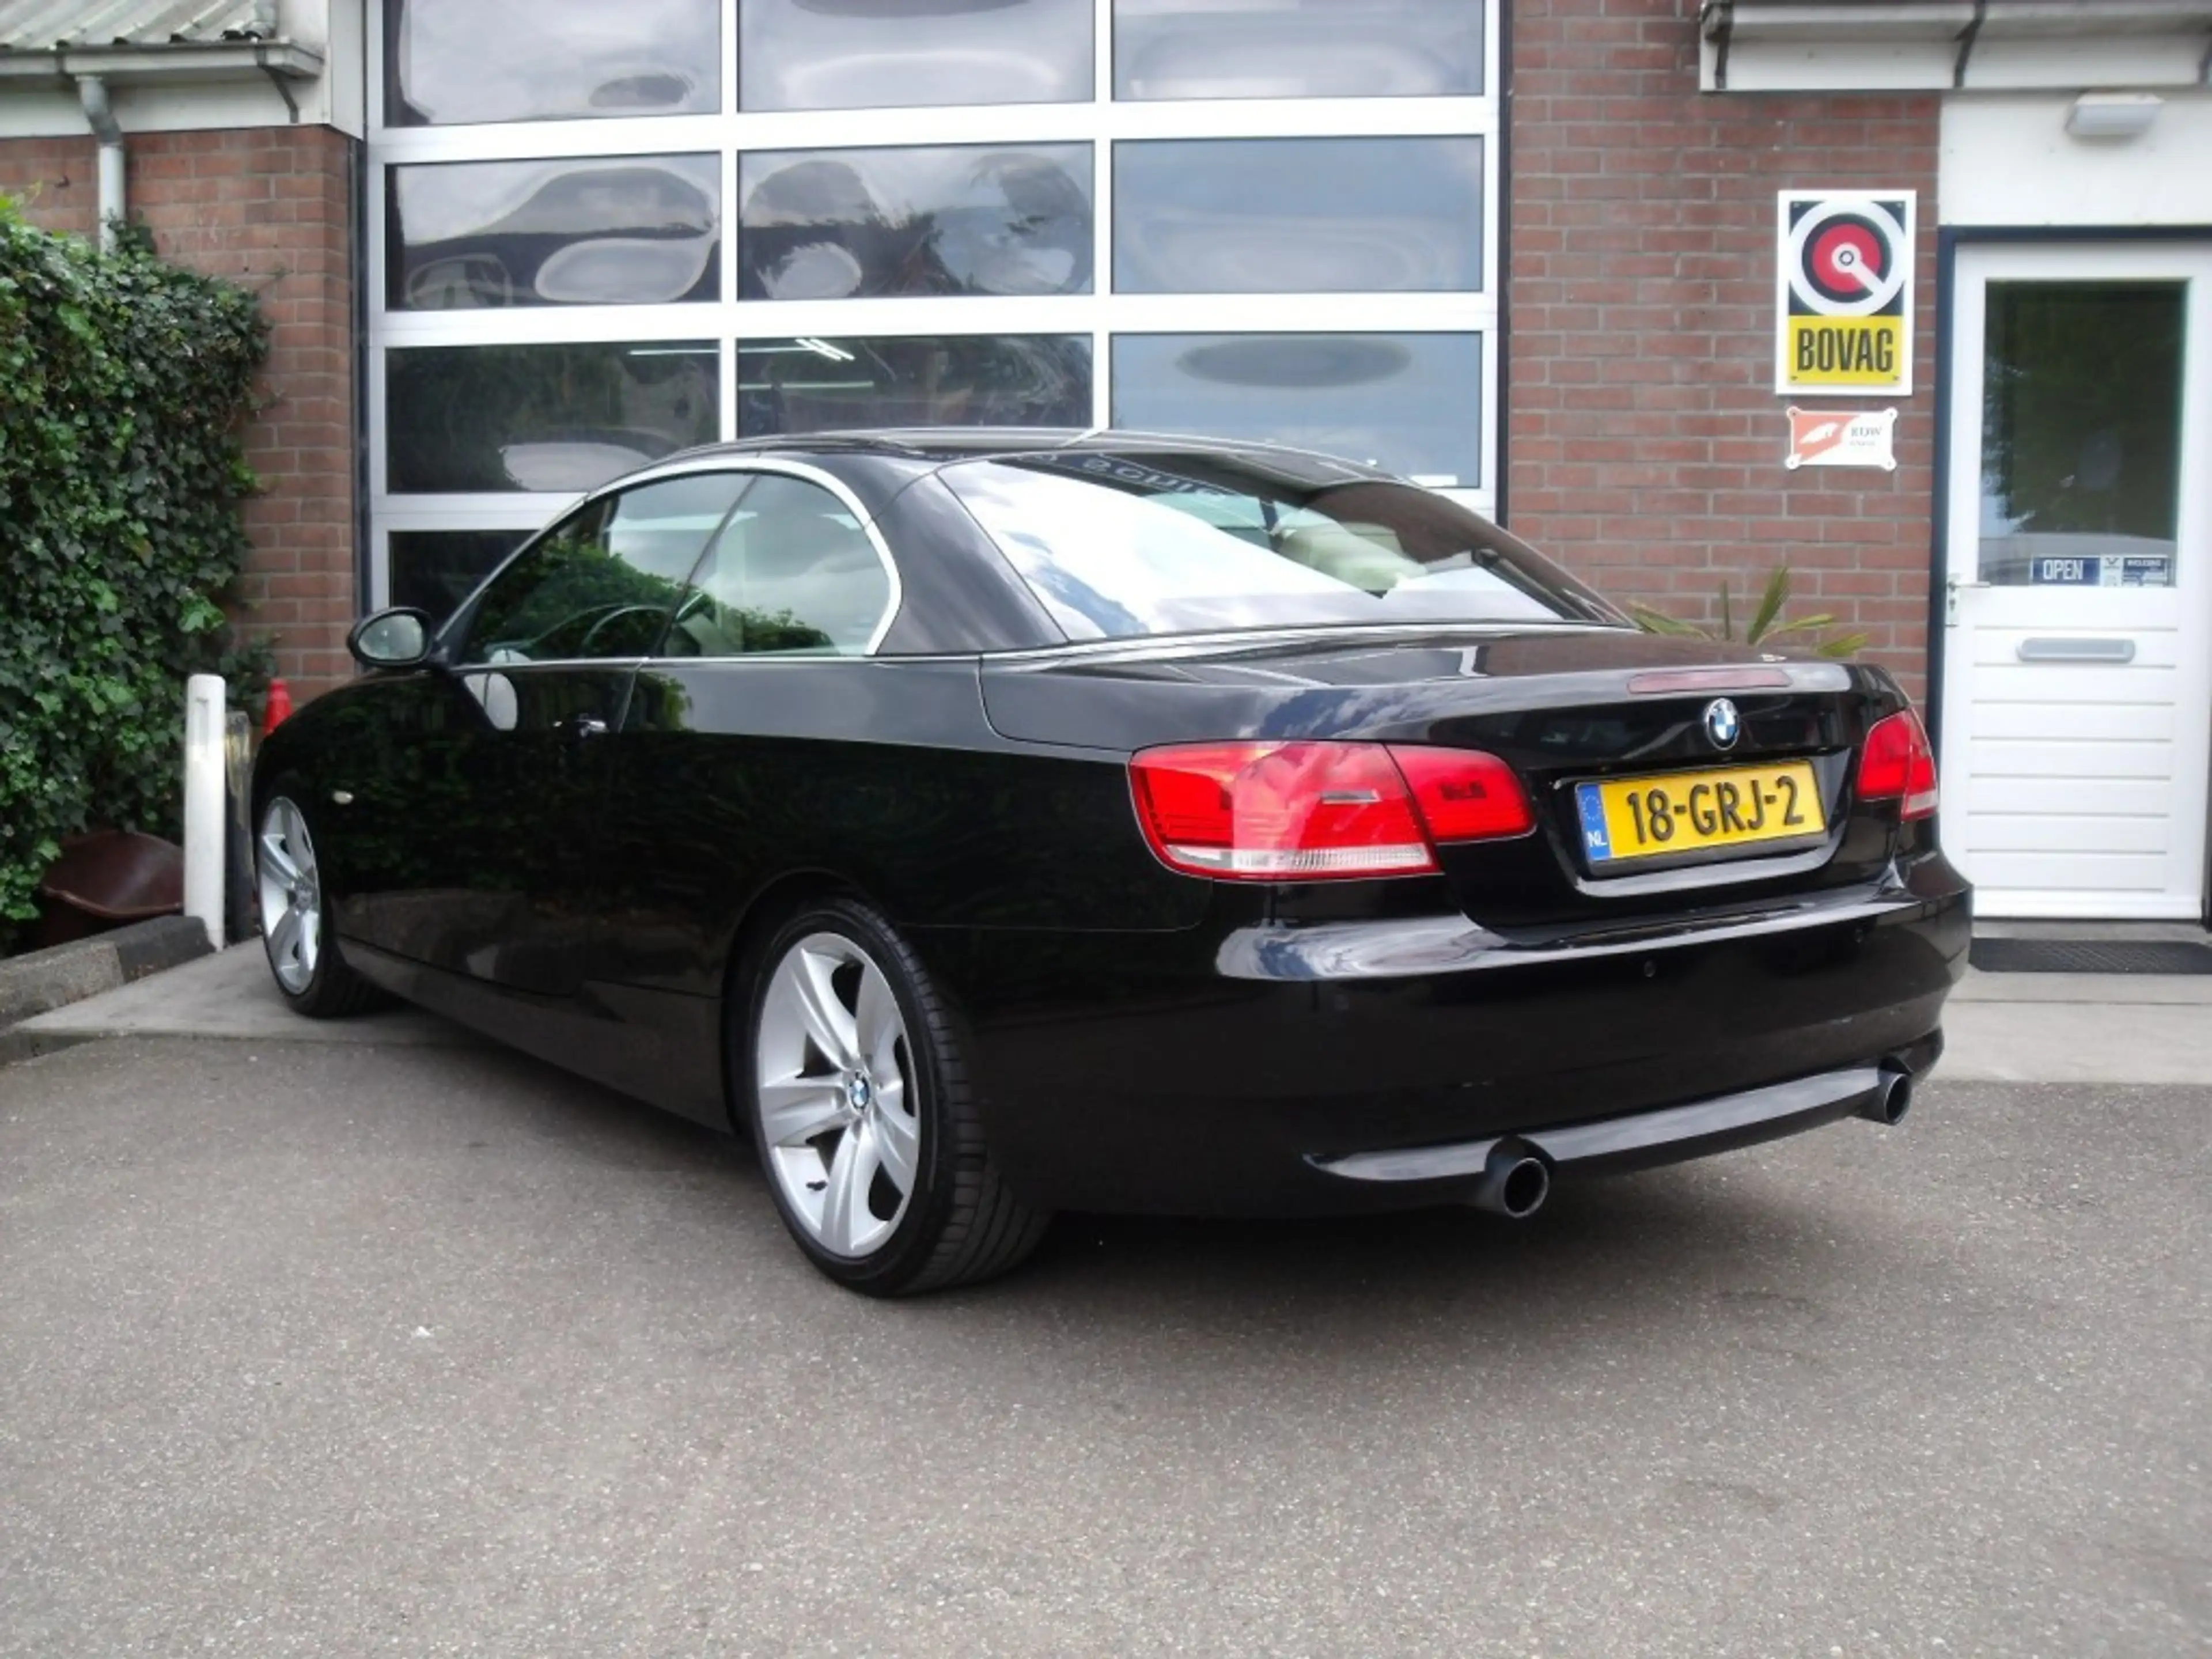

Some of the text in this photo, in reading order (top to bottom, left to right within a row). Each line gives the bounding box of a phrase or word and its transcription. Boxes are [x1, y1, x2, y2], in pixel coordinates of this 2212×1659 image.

[1797, 328, 1893, 372] BOVAG
[2043, 559, 2083, 579] OPEN
[1627, 775, 1804, 844] 18-GRJ-2
[1586, 831, 1607, 847] NL
